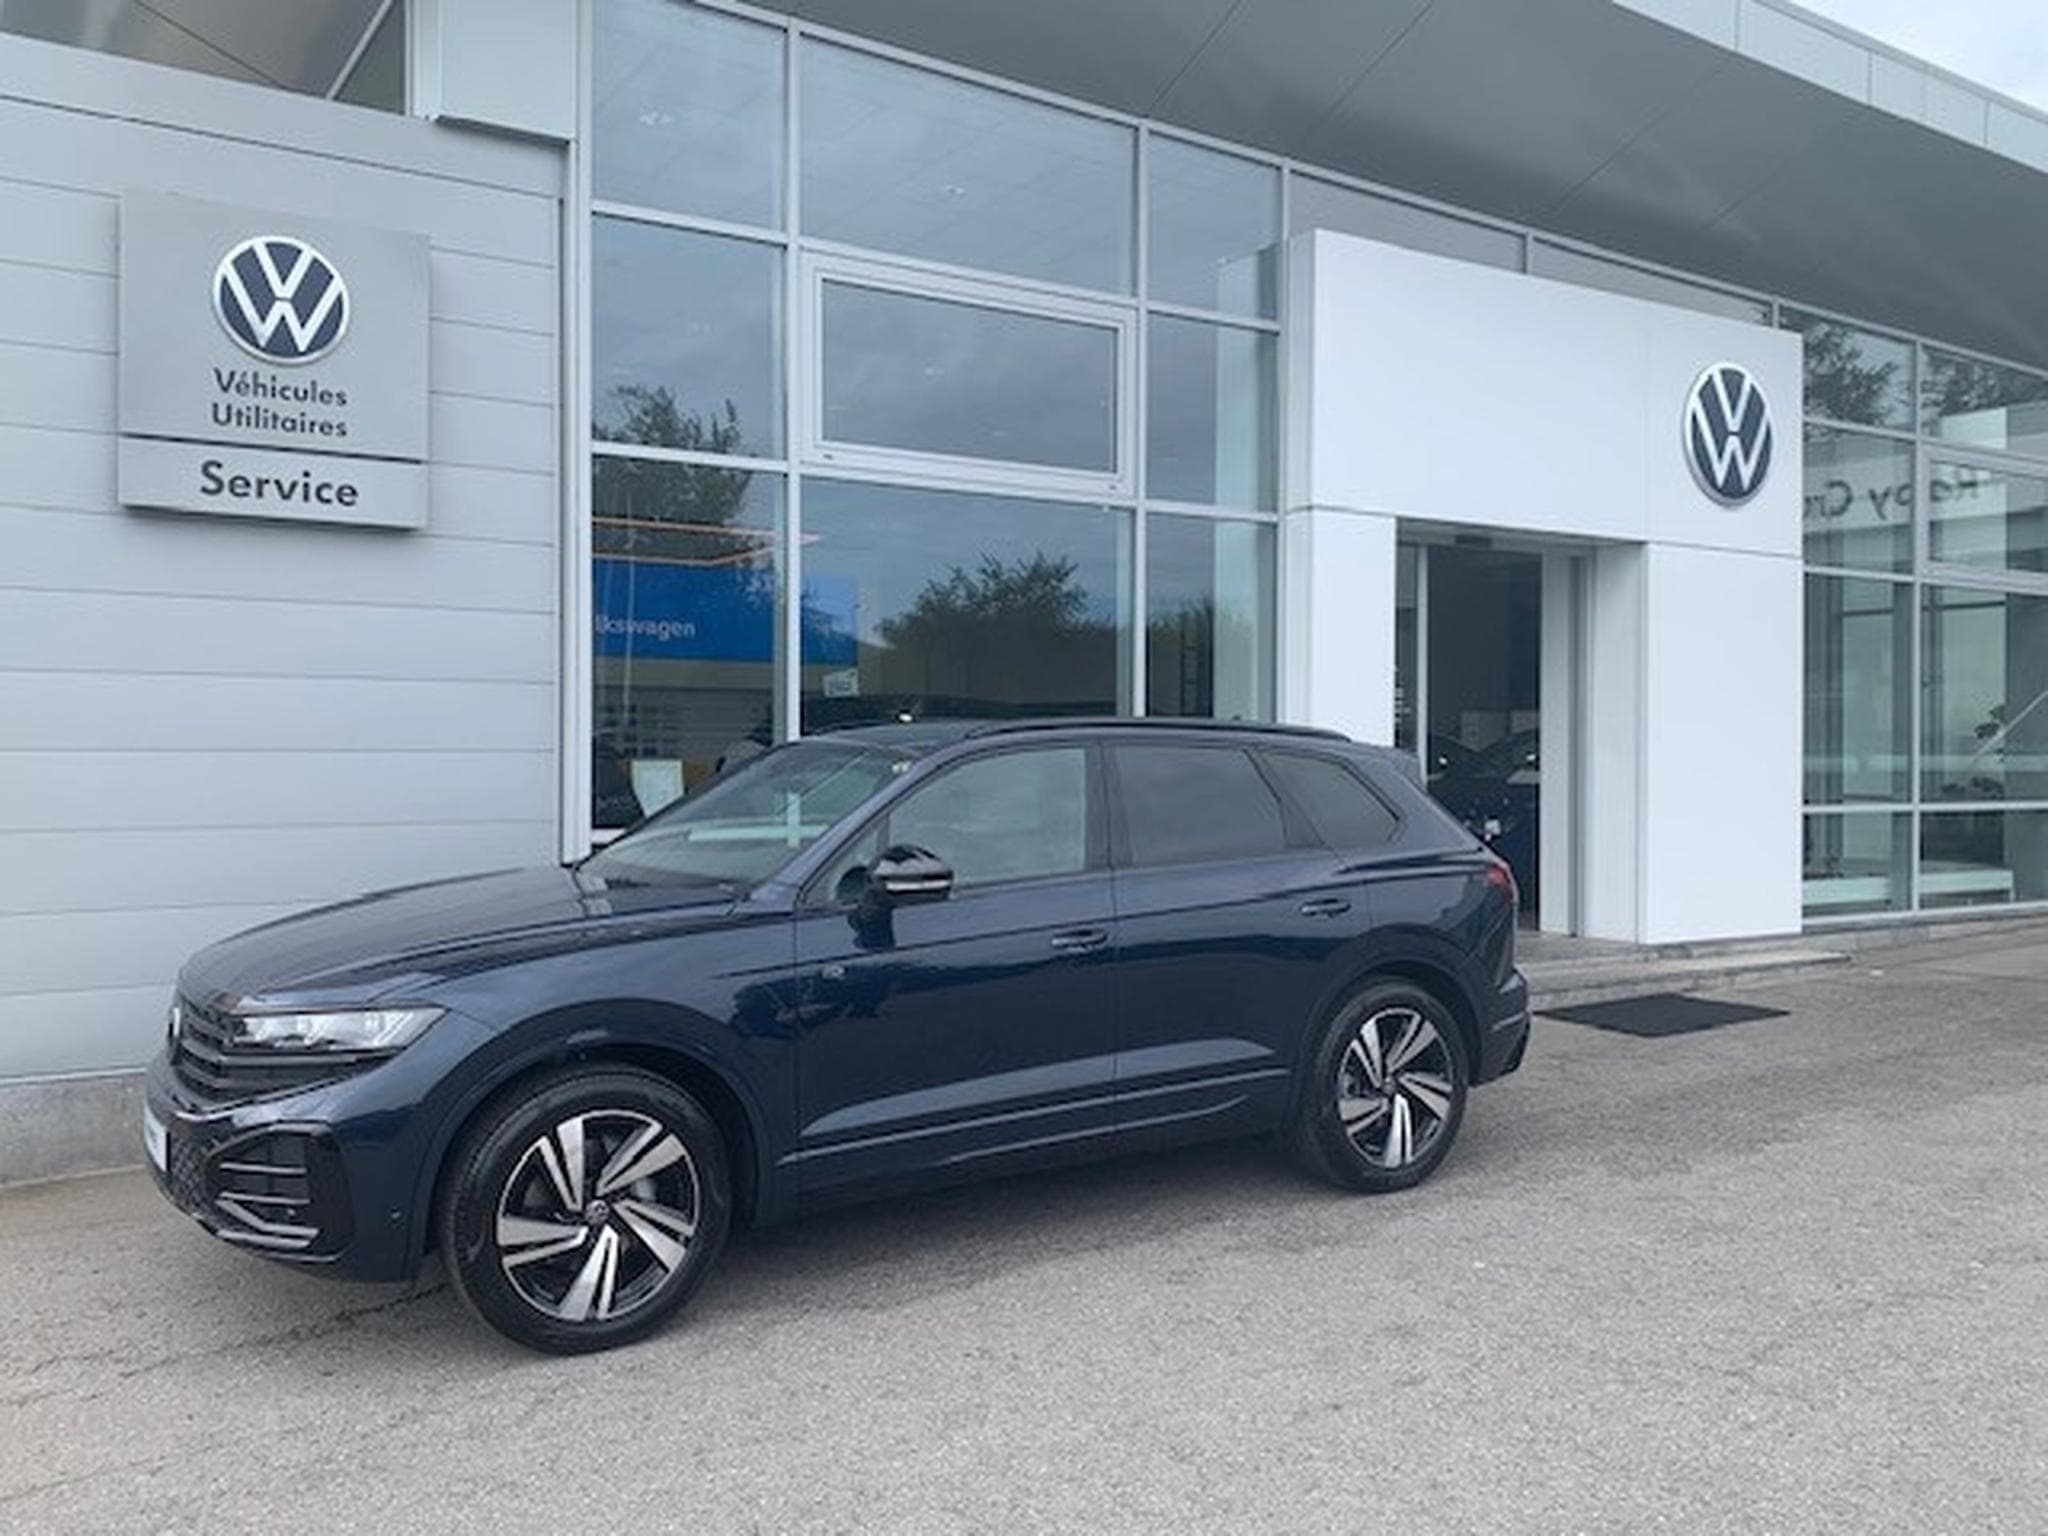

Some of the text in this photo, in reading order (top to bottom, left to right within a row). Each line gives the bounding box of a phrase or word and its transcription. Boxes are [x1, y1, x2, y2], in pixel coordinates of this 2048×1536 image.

[215, 237, 348, 361] VW
[213, 367, 348, 406] Véhicules
[211, 402, 348, 437] Utilitaires
[1685, 363, 1774, 500] VW
[200, 459, 358, 507] Service
